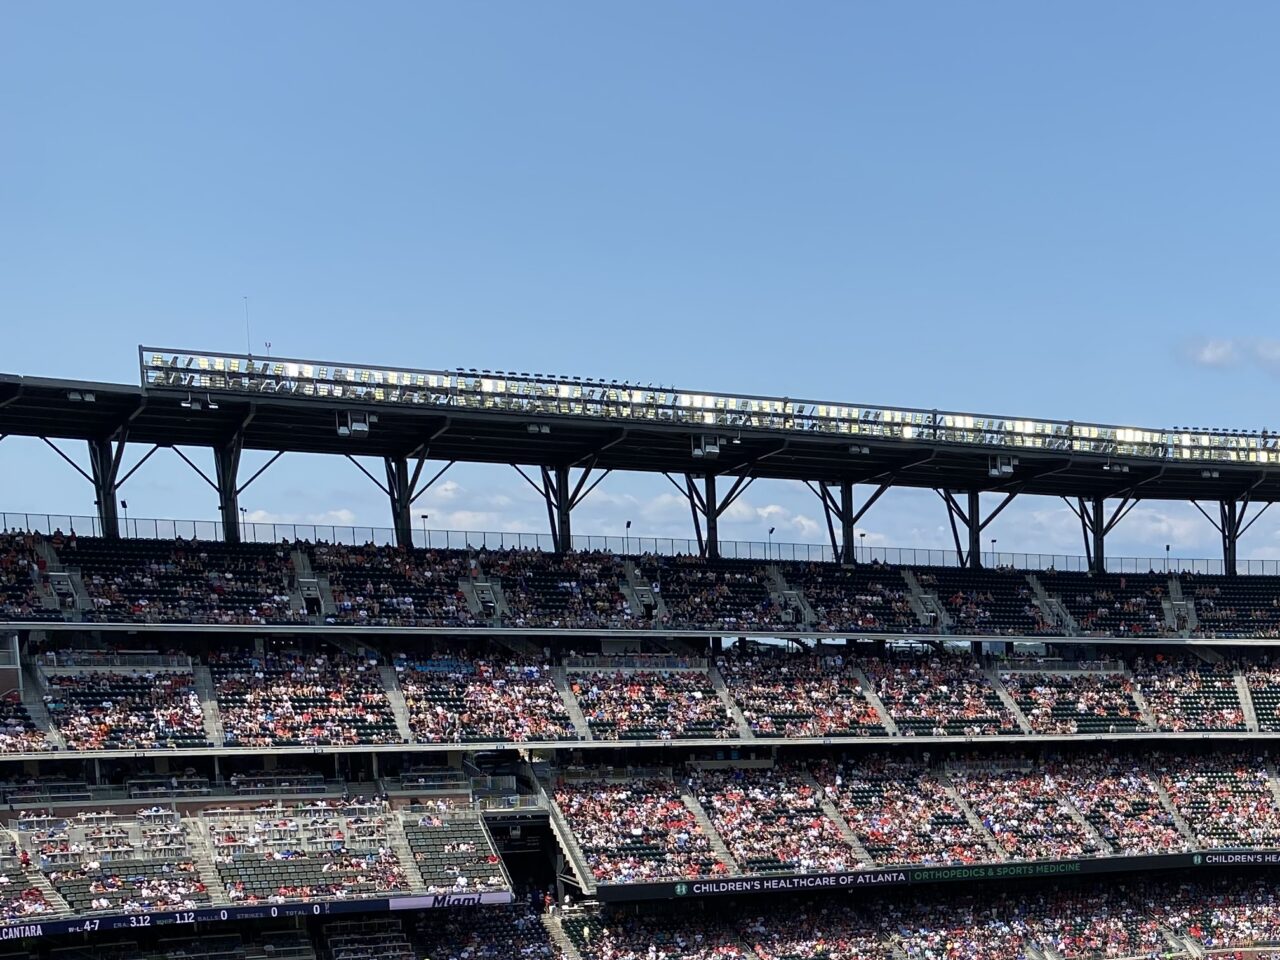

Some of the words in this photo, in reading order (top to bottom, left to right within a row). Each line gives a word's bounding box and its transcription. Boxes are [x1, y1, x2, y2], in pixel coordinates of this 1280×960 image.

[1206, 854, 1262, 863] CHILDREN'S
[693, 880, 761, 894] CHILDREN'S
[764, 876, 836, 889] HEALTHCARE
[839, 875, 854, 885] OF
[857, 872, 905, 884] ATLANTA
[914, 868, 985, 881] ORTHOPEDICS
[987, 867, 994, 877] &
[996, 866, 1034, 876] SPORTS
[1036, 863, 1081, 874] MEDICINE
[432, 894, 482, 908] Miami
[0, 924, 43, 940] LCANTARA
[84, 920, 100, 931] 4-7
[130, 916, 150, 927] 3.12
[176, 912, 195, 924] 1.12
[221, 910, 228, 920] 0
[271, 906, 278, 918] 0
[313, 904, 320, 914] 0
